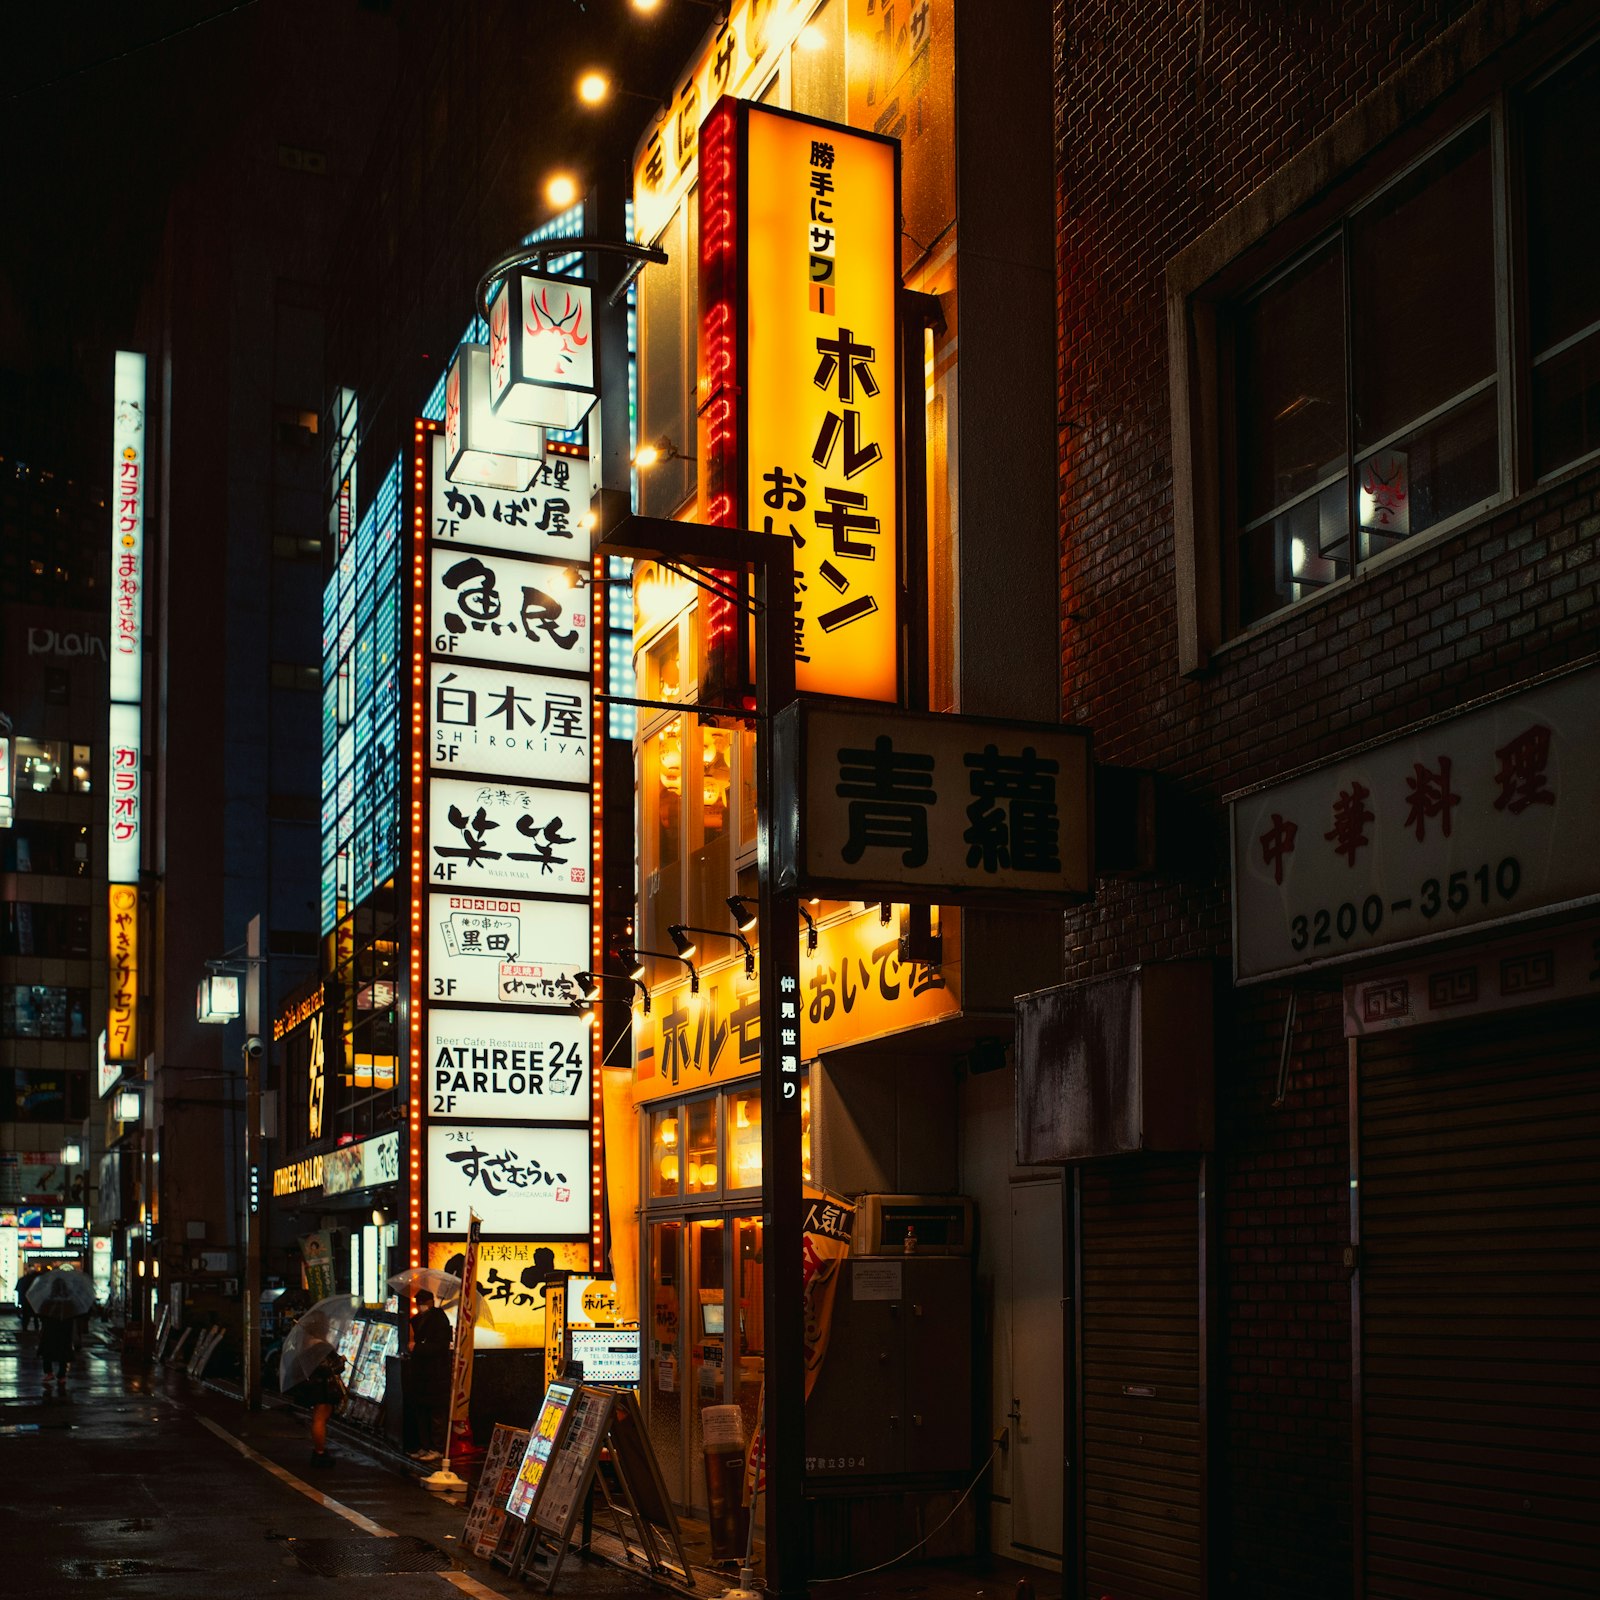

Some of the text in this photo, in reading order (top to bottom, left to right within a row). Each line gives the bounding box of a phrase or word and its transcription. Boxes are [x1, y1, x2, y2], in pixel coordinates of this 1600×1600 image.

[809, 141, 835, 314] 勝手にサワー
[120, 462, 138, 532] カラオケ
[812, 327, 883, 633] ホルモン
[436, 518, 460, 538] 7F
[444, 486, 573, 539] かば屋
[763, 466, 811, 663] おい
[118, 553, 138, 654] まねきねこ
[441, 557, 579, 650] 魚民
[435, 634, 459, 653] 6F
[436, 673, 587, 740] 白木屋
[435, 744, 459, 763] 5F
[114, 748, 137, 840] カラオケ
[1259, 723, 1557, 886] 中華料理
[433, 804, 577, 875] 笑笑
[433, 862, 457, 881] 4F
[1290, 857, 1522, 951] 3200-3510
[461, 930, 511, 952] 黒田
[114, 913, 133, 1057] やきとりセンター
[433, 978, 457, 996] 3F
[436, 1036, 544, 1049] Beer Cafe Restaurant
[661, 978, 762, 1086] ホルモ
[781, 975, 797, 1099] 仲見世通り
[435, 1047, 545, 1071] ATHREE
[436, 1071, 544, 1095] PARLOR
[433, 1095, 457, 1113] 2F
[445, 1131, 474, 1142] つきじ
[433, 1210, 457, 1229] 1F
[479, 1244, 529, 1262] 居楽屋
[585, 1298, 620, 1311] ホルモ
